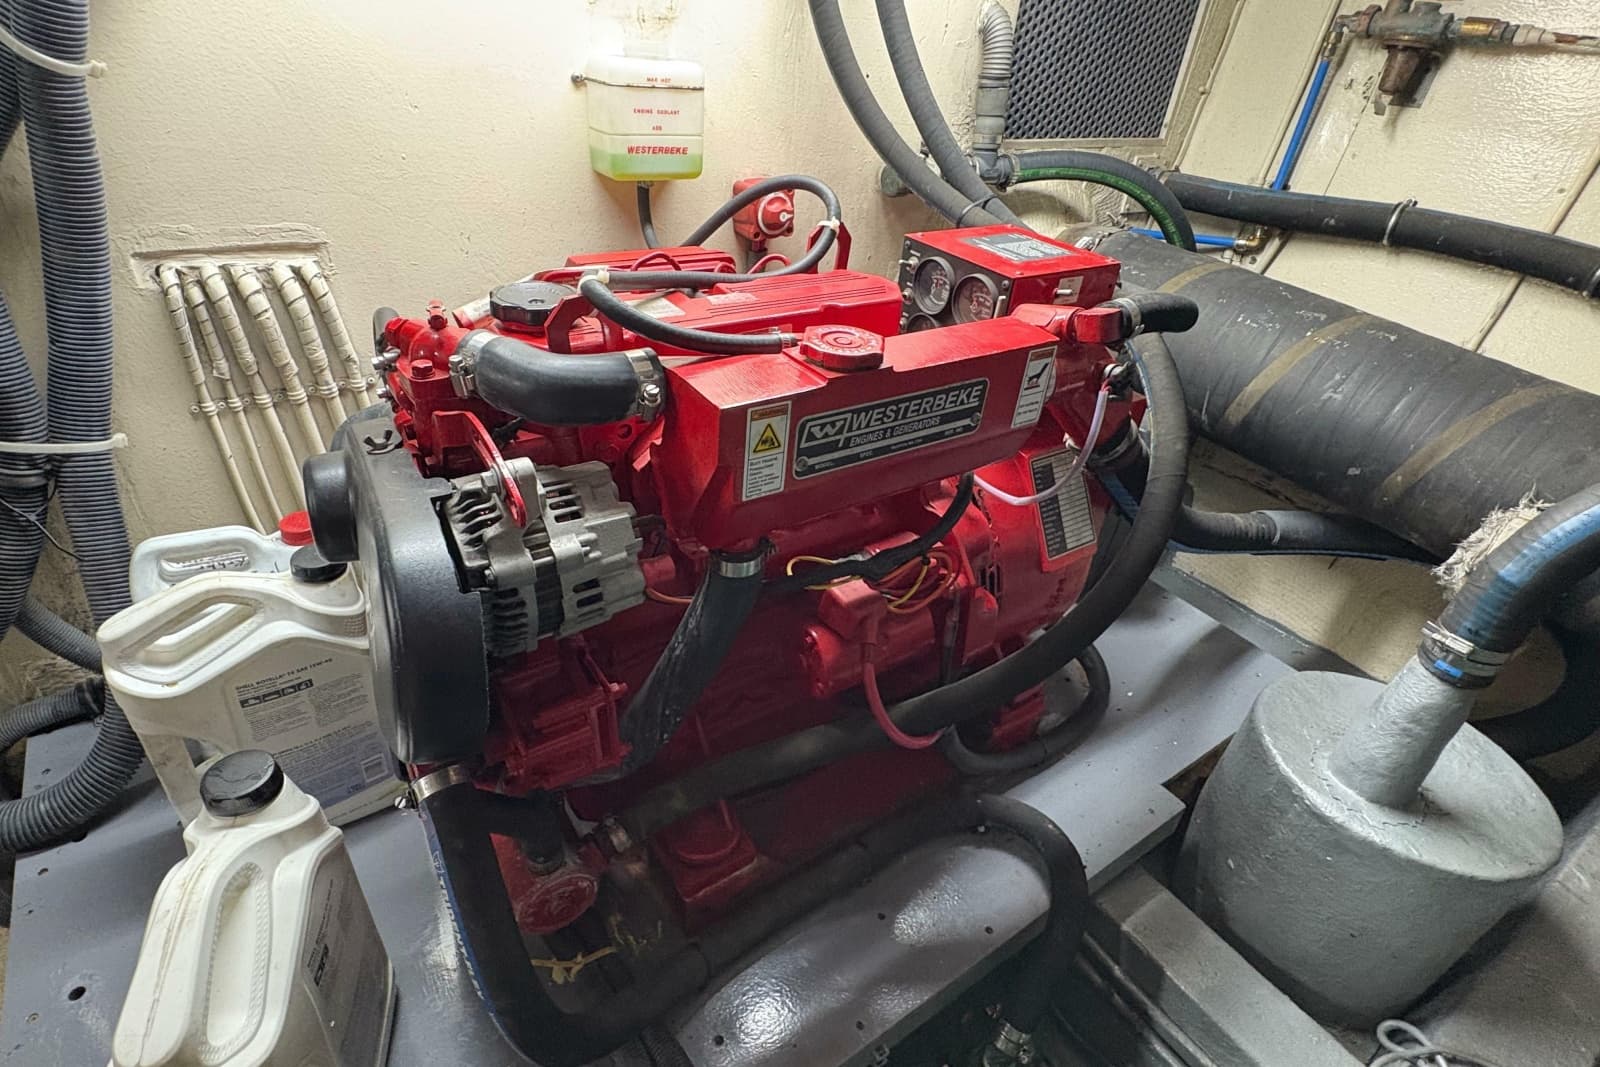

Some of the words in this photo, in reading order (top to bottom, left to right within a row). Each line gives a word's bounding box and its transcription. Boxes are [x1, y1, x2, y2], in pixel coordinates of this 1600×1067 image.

[627, 146, 689, 155] WESTERBEKE
[851, 384, 984, 431] WESTERBEKE
[849, 430, 884, 447] ENGINES
[885, 428, 891, 438] &
[893, 416, 940, 436] GENERATORS
